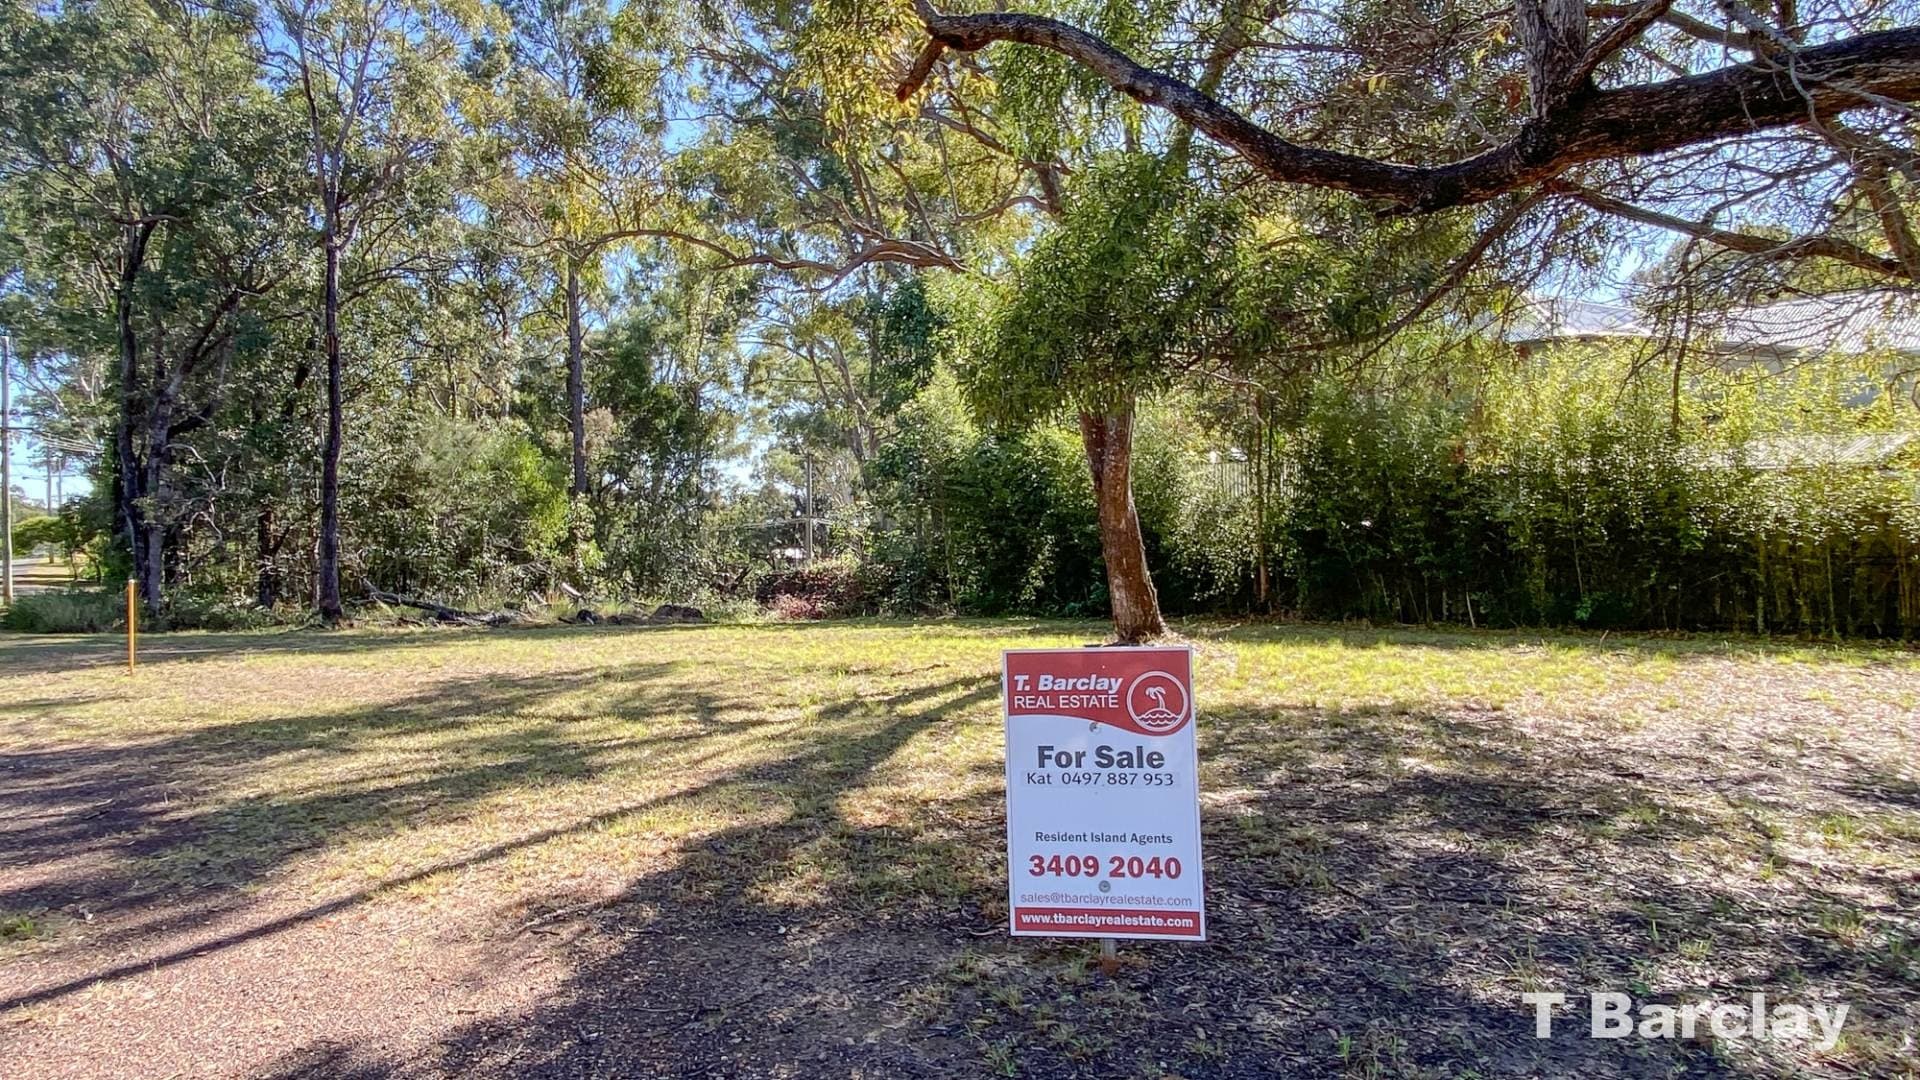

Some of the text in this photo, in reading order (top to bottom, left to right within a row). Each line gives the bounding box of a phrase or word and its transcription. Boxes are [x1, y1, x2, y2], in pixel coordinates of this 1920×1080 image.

[1014, 674, 1123, 694] T. Barclay
[1014, 694, 1119, 709] REAL ESTATE
[1037, 745, 1165, 769] For Sale
[1027, 772, 1174, 786] Kat 0497 887 953
[1035, 831, 1173, 845] Resident Island Agents
[1028, 854, 1182, 879] 3409 2040
[1020, 892, 1193, 907] sales@tbarclayrealestate.com
[1021, 912, 1193, 928] www.tbarclayrealestate.com
